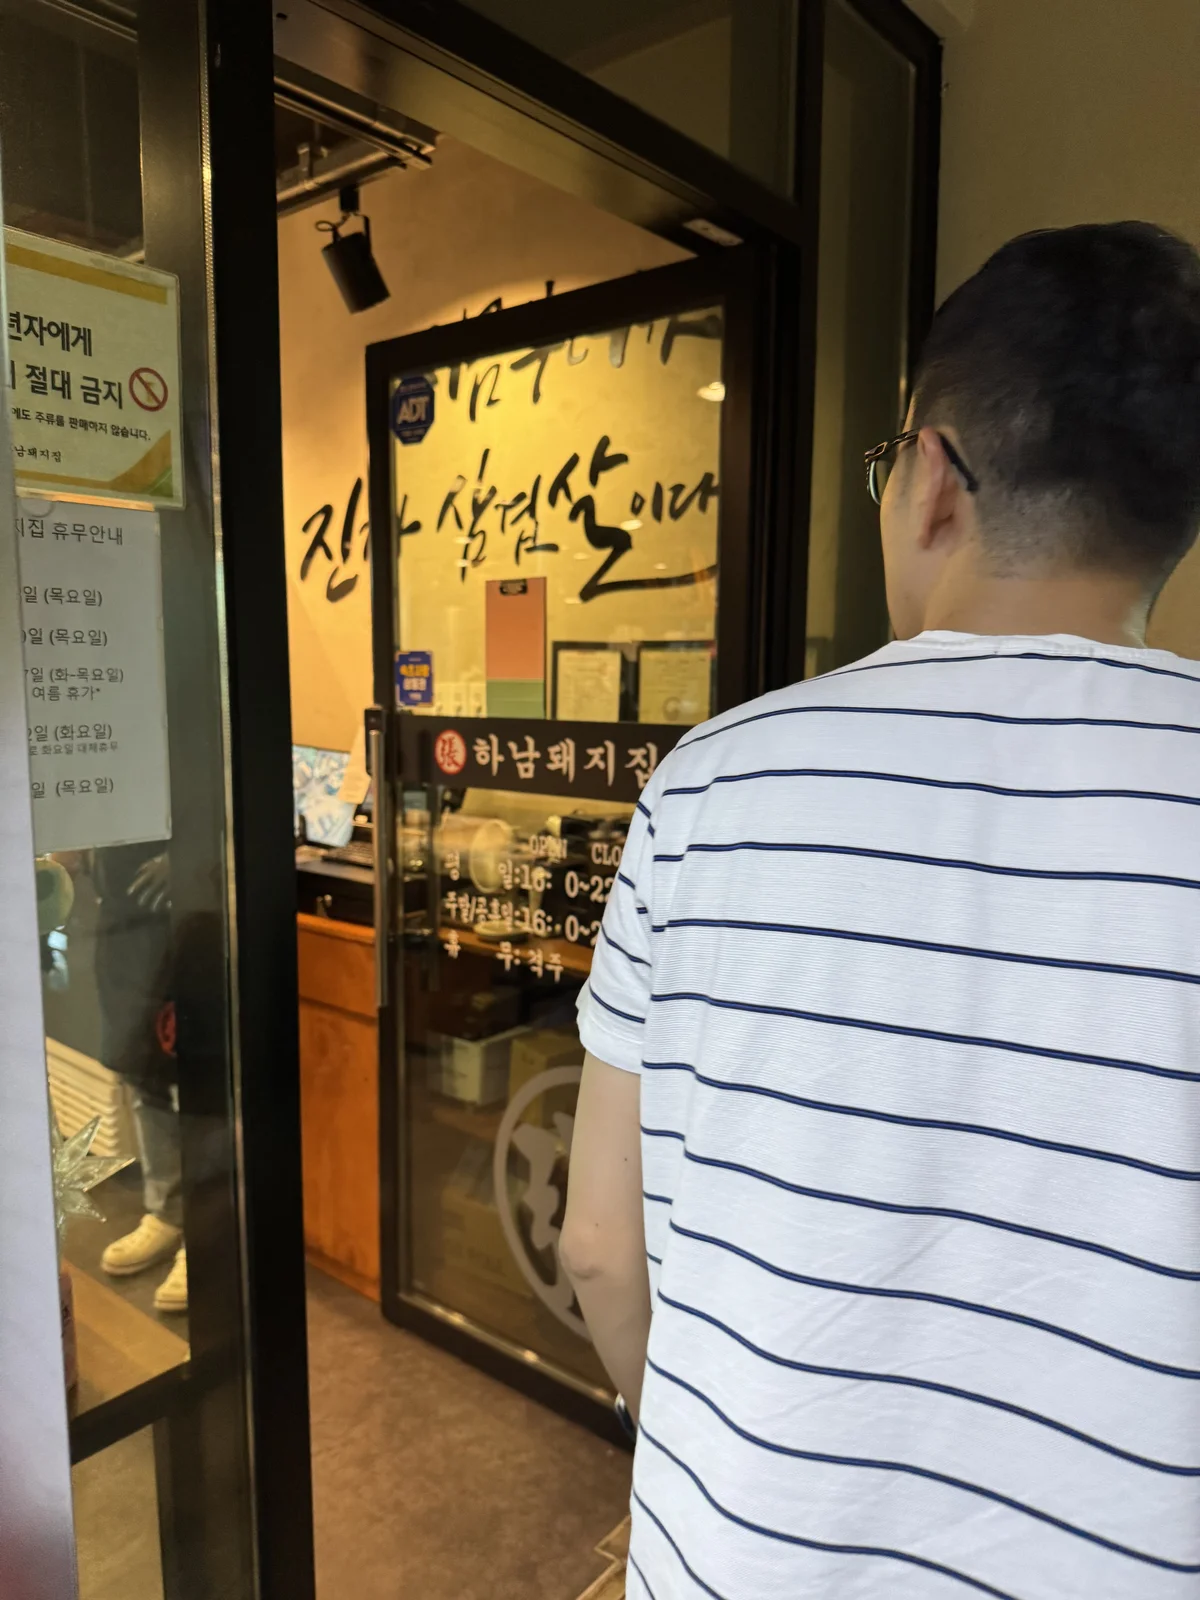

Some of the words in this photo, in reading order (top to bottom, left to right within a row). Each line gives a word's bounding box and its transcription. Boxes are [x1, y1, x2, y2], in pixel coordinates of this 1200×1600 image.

[25, 363, 72, 400] 절대
[80, 375, 123, 409] 금지
[396, 396, 429, 424] ADT
[35, 411, 65, 427] 주류를
[69, 416, 107, 434] 판매하지
[111, 424, 151, 441] 않습니다.
[11, 445, 61, 463] 남돼지집
[52, 522, 123, 546] 휴무안내
[44, 587, 102, 607] (목요일)
[50, 629, 108, 646] (목요일)
[50, 667, 124, 683] (화-목요일)
[32, 686, 61, 701] 여름
[55, 724, 112, 741] (화요일)
[472, 733, 659, 789] 하남돼지집
[56, 777, 114, 797] (목요일)
